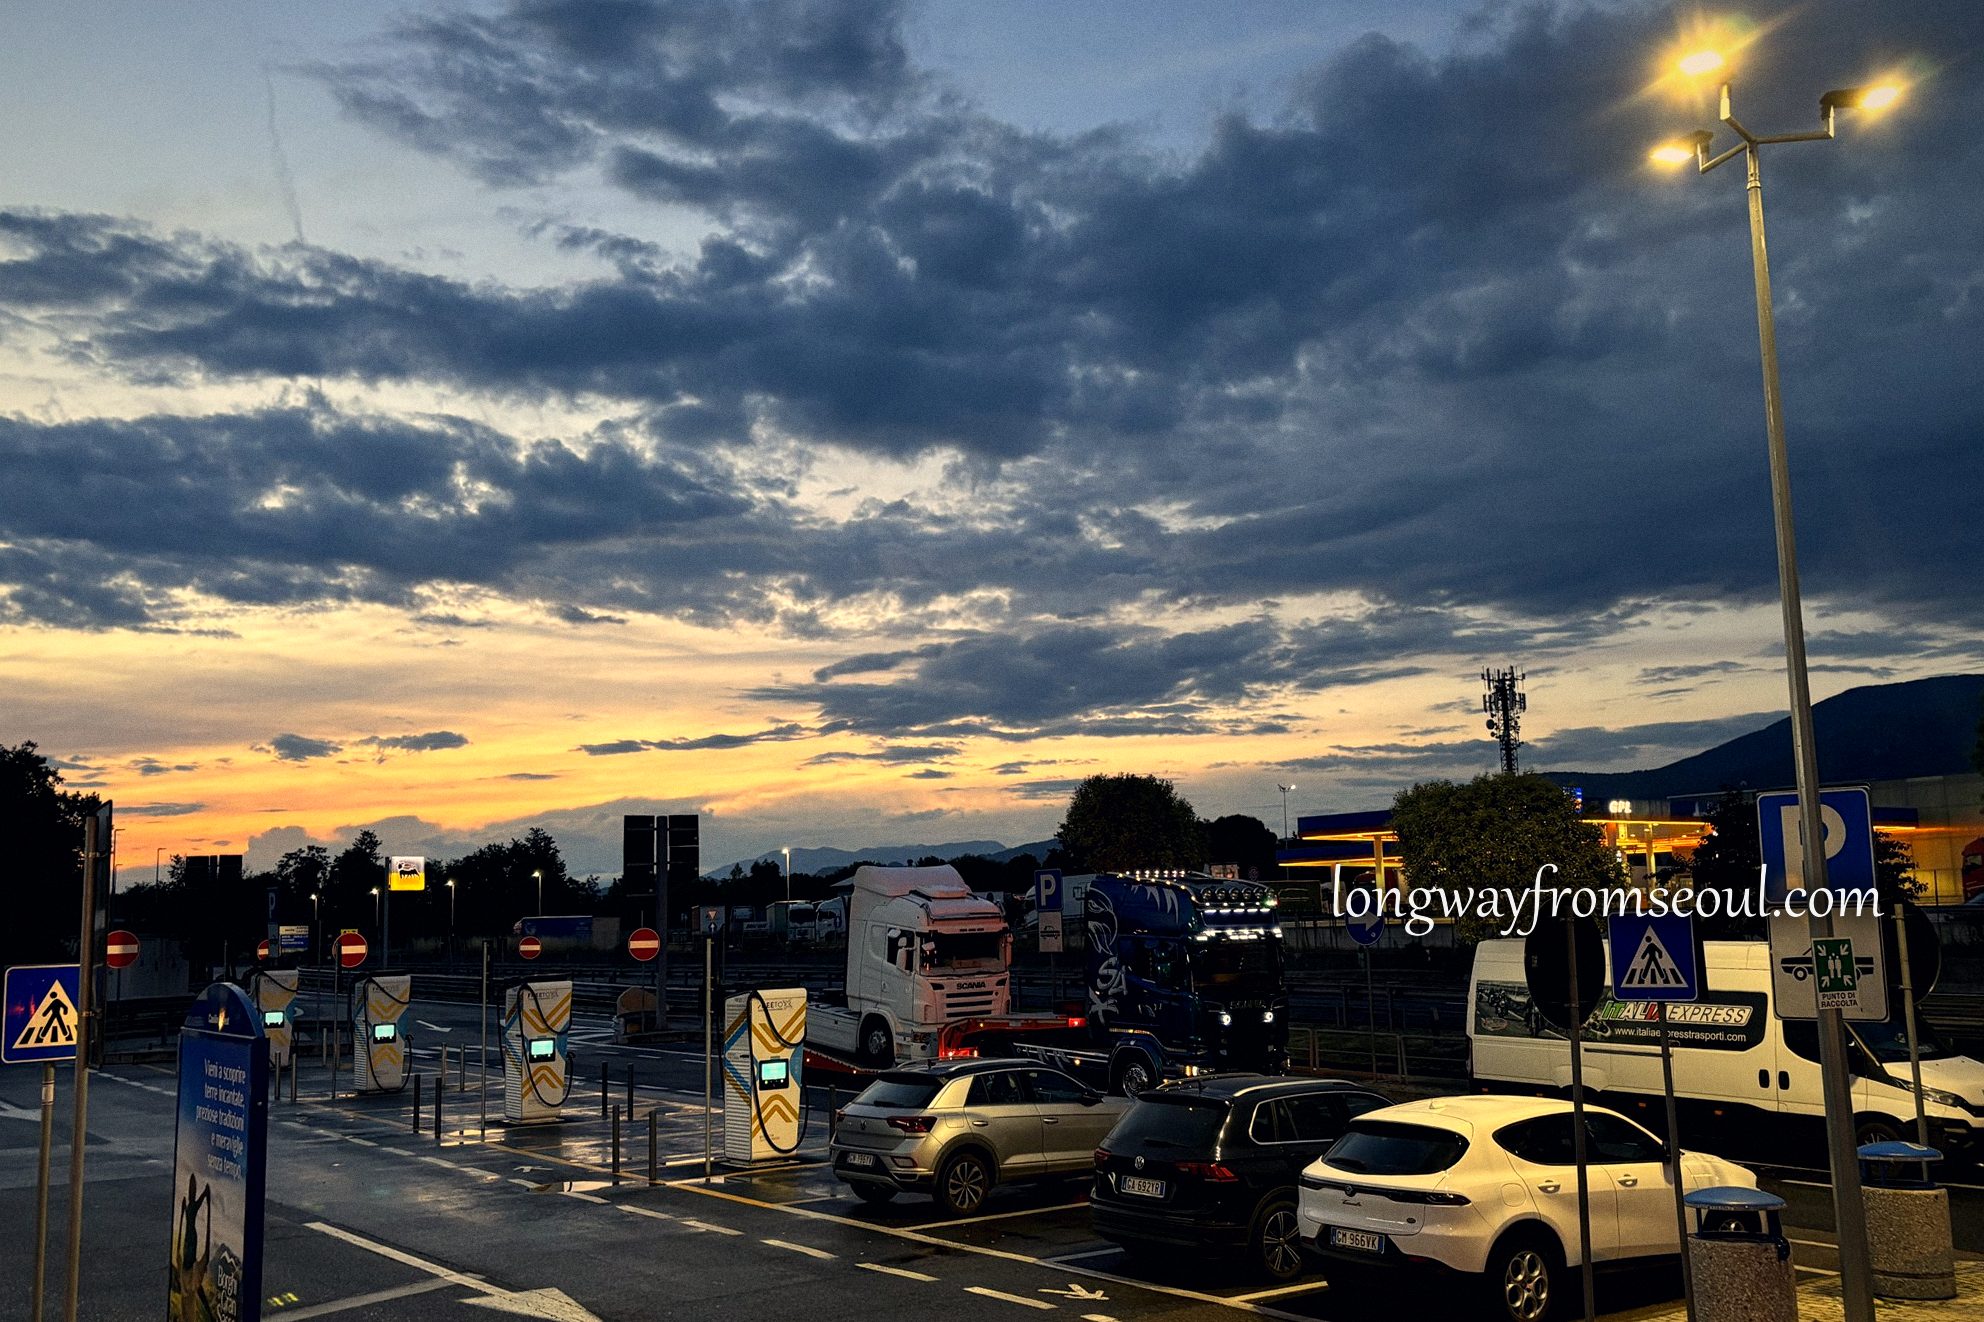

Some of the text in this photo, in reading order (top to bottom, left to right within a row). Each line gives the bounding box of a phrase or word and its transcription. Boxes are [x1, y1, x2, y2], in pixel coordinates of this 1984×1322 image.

[1609, 800, 1632, 813] GPL
[1780, 804, 1846, 890] P
[1039, 874, 1057, 907] P
[956, 981, 986, 990] SCANIA
[1821, 1000, 1858, 1008] RACCOLTA
[1822, 992, 1846, 1000] PUNTO
[1667, 1006, 1746, 1023] EXPRESS
[1615, 1027, 1747, 1043] www.italiaeresstrasporti.com
[204, 1057, 246, 1087] Vieni a scoprire
[204, 1082, 218, 1101] terre
[196, 1105, 245, 1131] preziose tradizioni
[211, 1132, 244, 1158] e meraviglie
[207, 1153, 223, 1172] senza
[217, 1265, 238, 1297] Borghi
[220, 1289, 237, 1317] Gran
